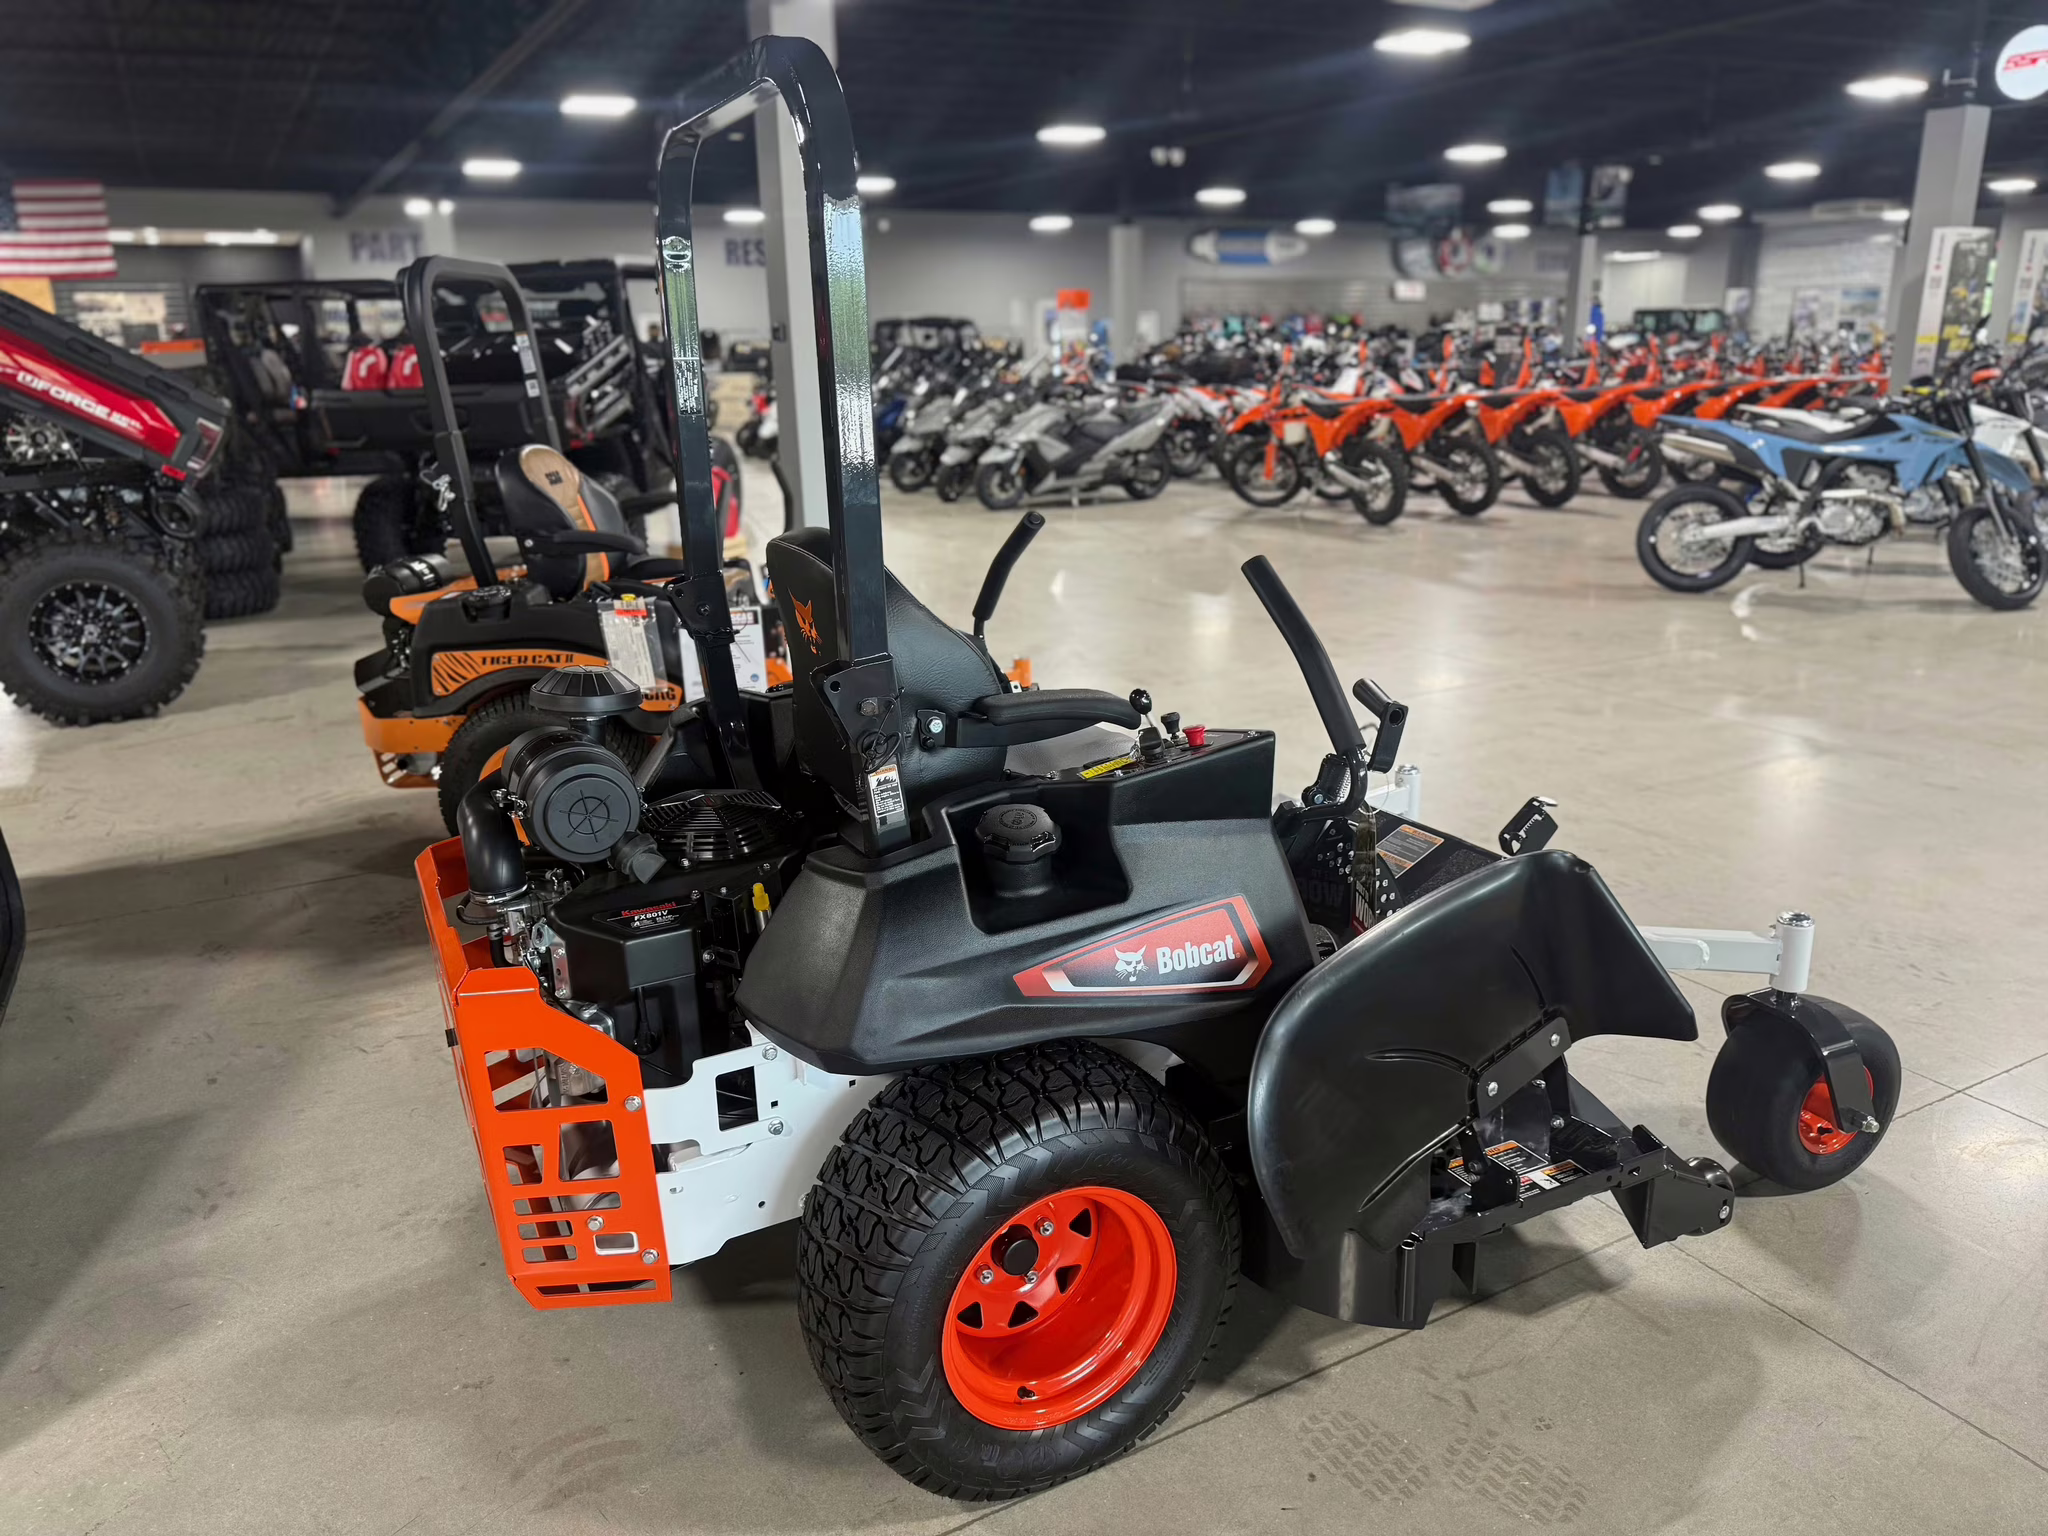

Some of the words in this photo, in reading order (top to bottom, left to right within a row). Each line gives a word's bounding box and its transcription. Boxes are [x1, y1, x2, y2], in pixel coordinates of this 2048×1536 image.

[641, 686, 676, 700] CAG
[634, 909, 668, 921] FX801V
[1156, 935, 1236, 974] Bobcat
